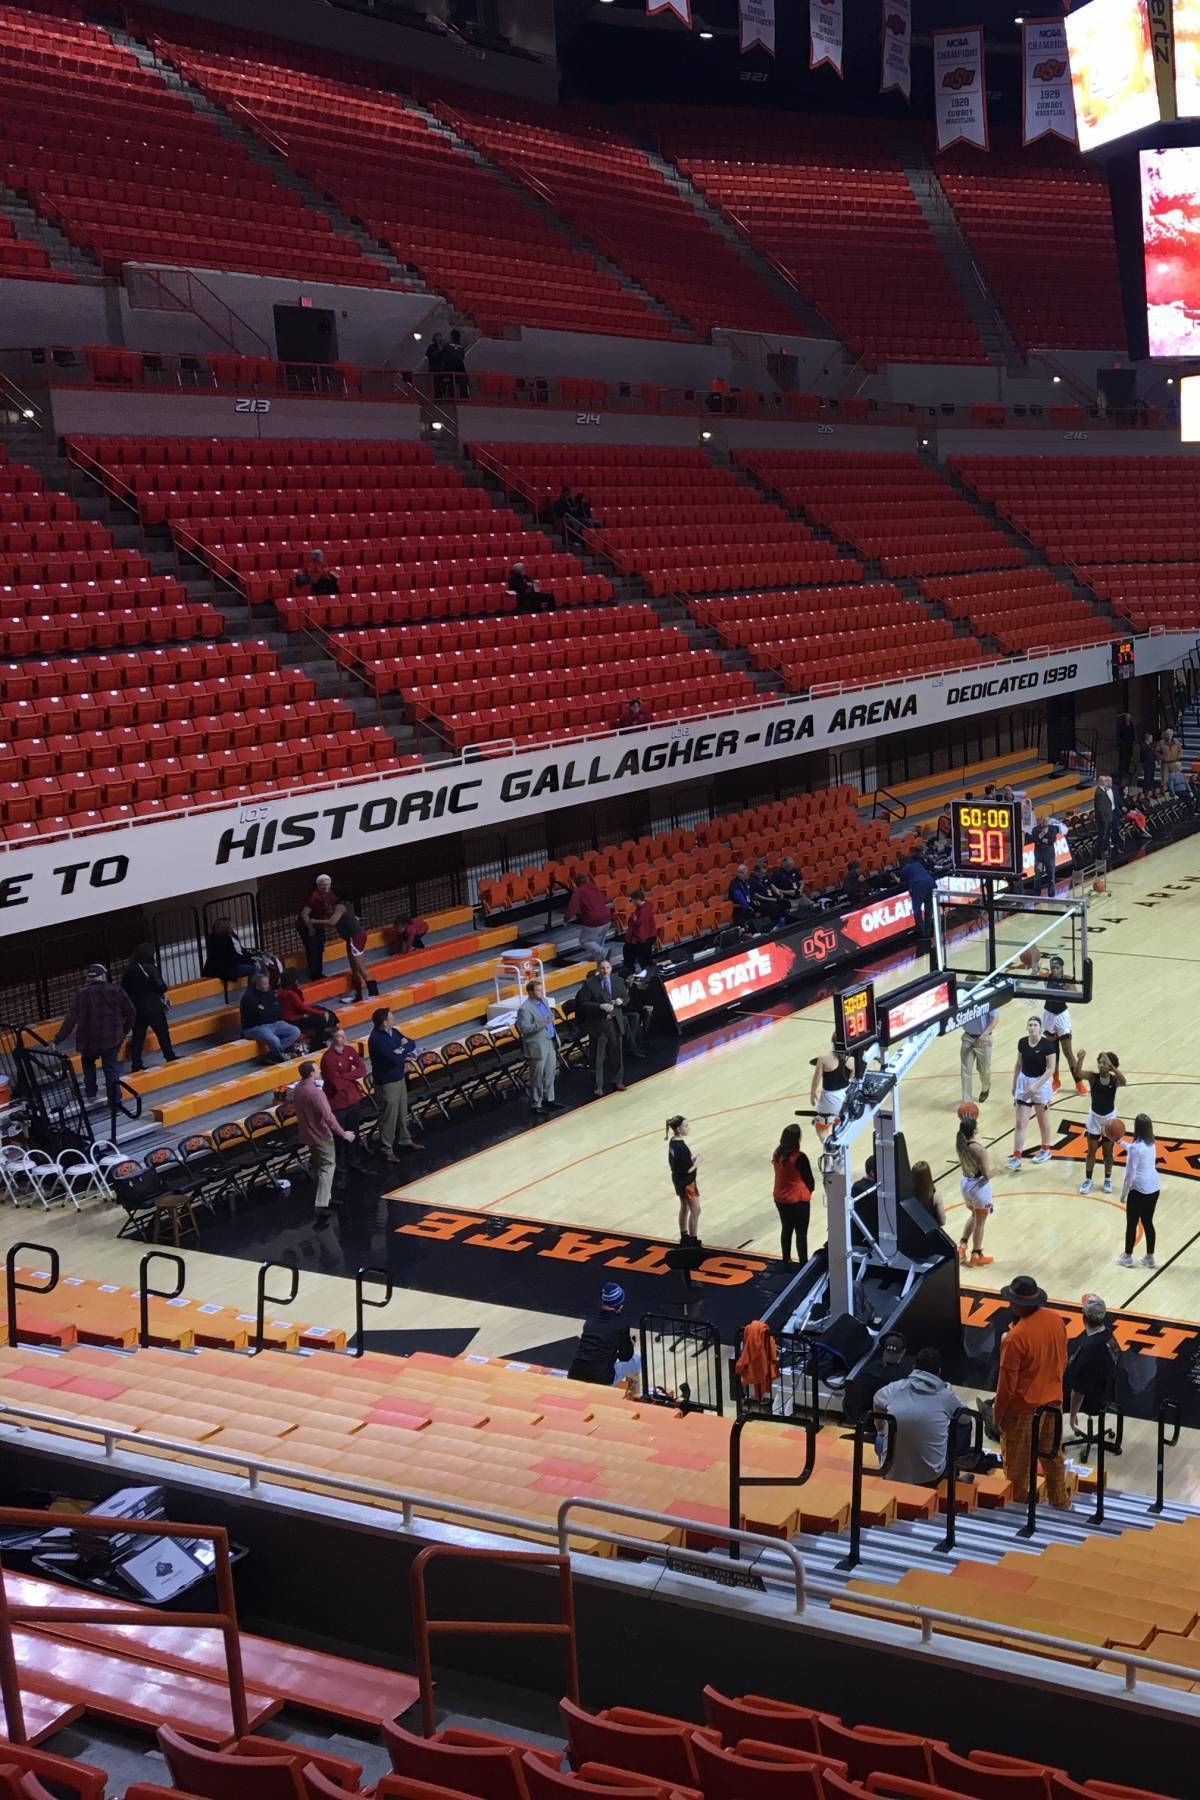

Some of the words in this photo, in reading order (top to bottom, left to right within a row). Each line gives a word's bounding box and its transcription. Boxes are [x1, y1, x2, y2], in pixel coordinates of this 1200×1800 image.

[946, 38, 969, 48] NCAA
[235, 399, 271, 414] 213
[577, 413, 600, 424] 214
[1063, 431, 1089, 440] 216
[947, 673, 1039, 706] DEDICATED
[1042, 663, 1078, 685] 1938
[53, 854, 130, 895] TO
[215, 779, 482, 866] HISTORIC
[500, 714, 814, 803] GALLAGHER-IBA
[828, 693, 918, 734] ARENA
[960, 808, 1009, 828] 60:00
[967, 829, 1004, 864] 30
[802, 927, 838, 963] OSU
[708, 951, 772, 996] STATE
[848, 1012, 864, 1036] 30
[394, 1210, 769, 1287] STATE
